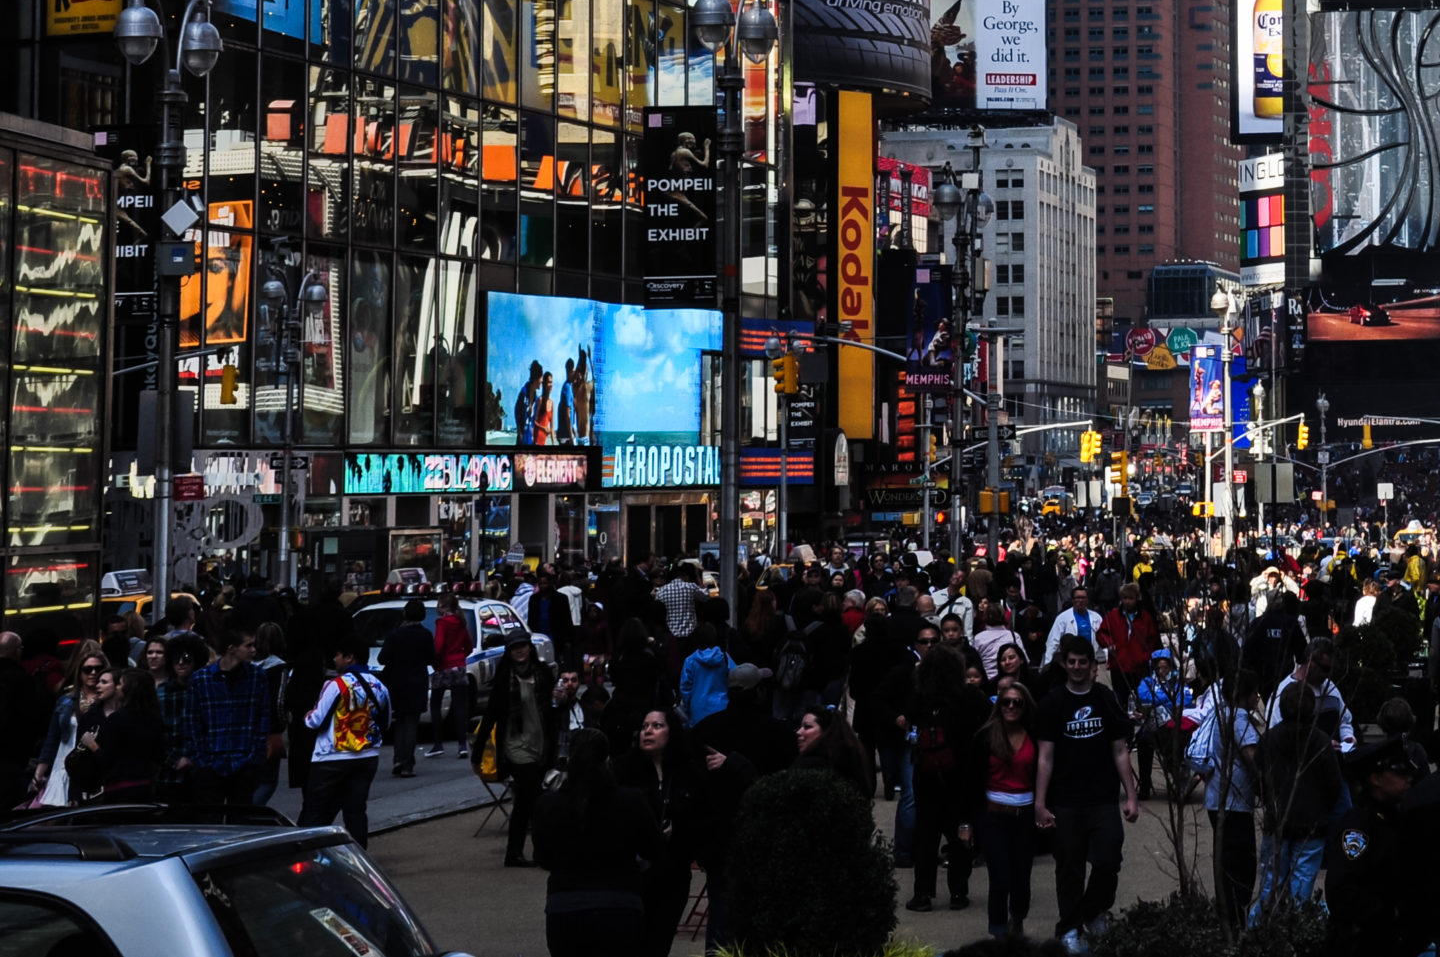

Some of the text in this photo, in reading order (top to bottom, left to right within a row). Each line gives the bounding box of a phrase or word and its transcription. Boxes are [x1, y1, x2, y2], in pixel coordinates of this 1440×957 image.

[883, 3, 924, 19] emotion
[1003, 0, 1020, 18] By
[983, 15, 1038, 34] George,
[1002, 36, 1021, 45] we
[991, 48, 1030, 63] did it.
[987, 75, 1034, 84] LEADERSHIP
[647, 178, 713, 192] POMPEII
[648, 204, 679, 216] THE
[648, 228, 709, 241] EXHIBIT
[841, 186, 869, 348] Kodak
[906, 373, 950, 385] MEMPHIS
[1190, 418, 1223, 428] MEMPHIS
[536, 458, 578, 484] ELEMENT
